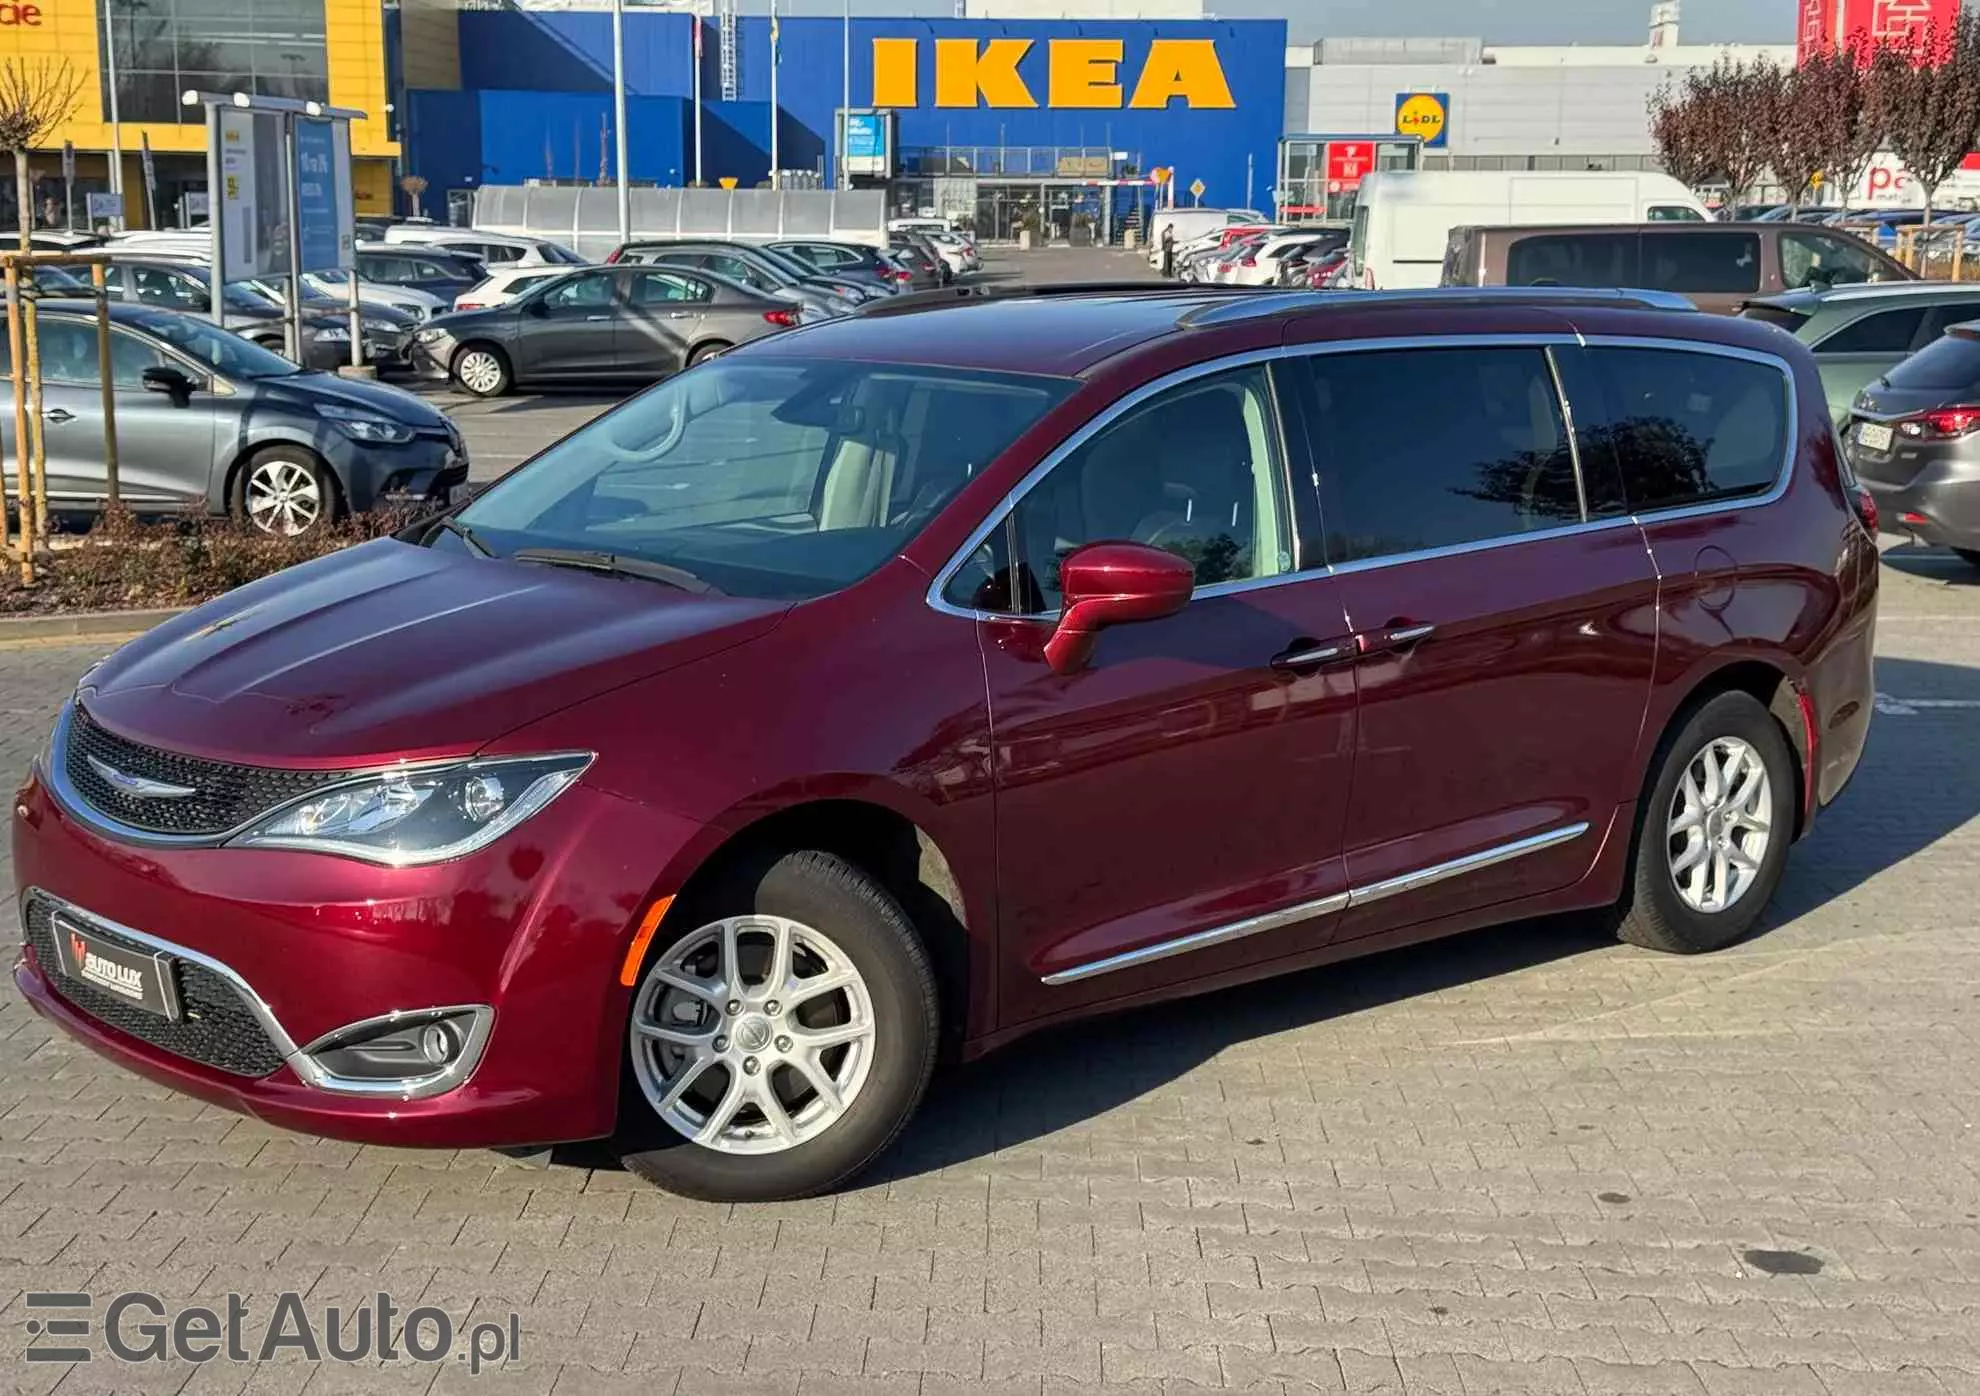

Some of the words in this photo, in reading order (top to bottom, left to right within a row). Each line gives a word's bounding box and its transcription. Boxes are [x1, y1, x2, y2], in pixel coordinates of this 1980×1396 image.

[873, 38, 1236, 108] IKEA
[84, 951, 117, 980] AUTO
[116, 963, 143, 988] LUX
